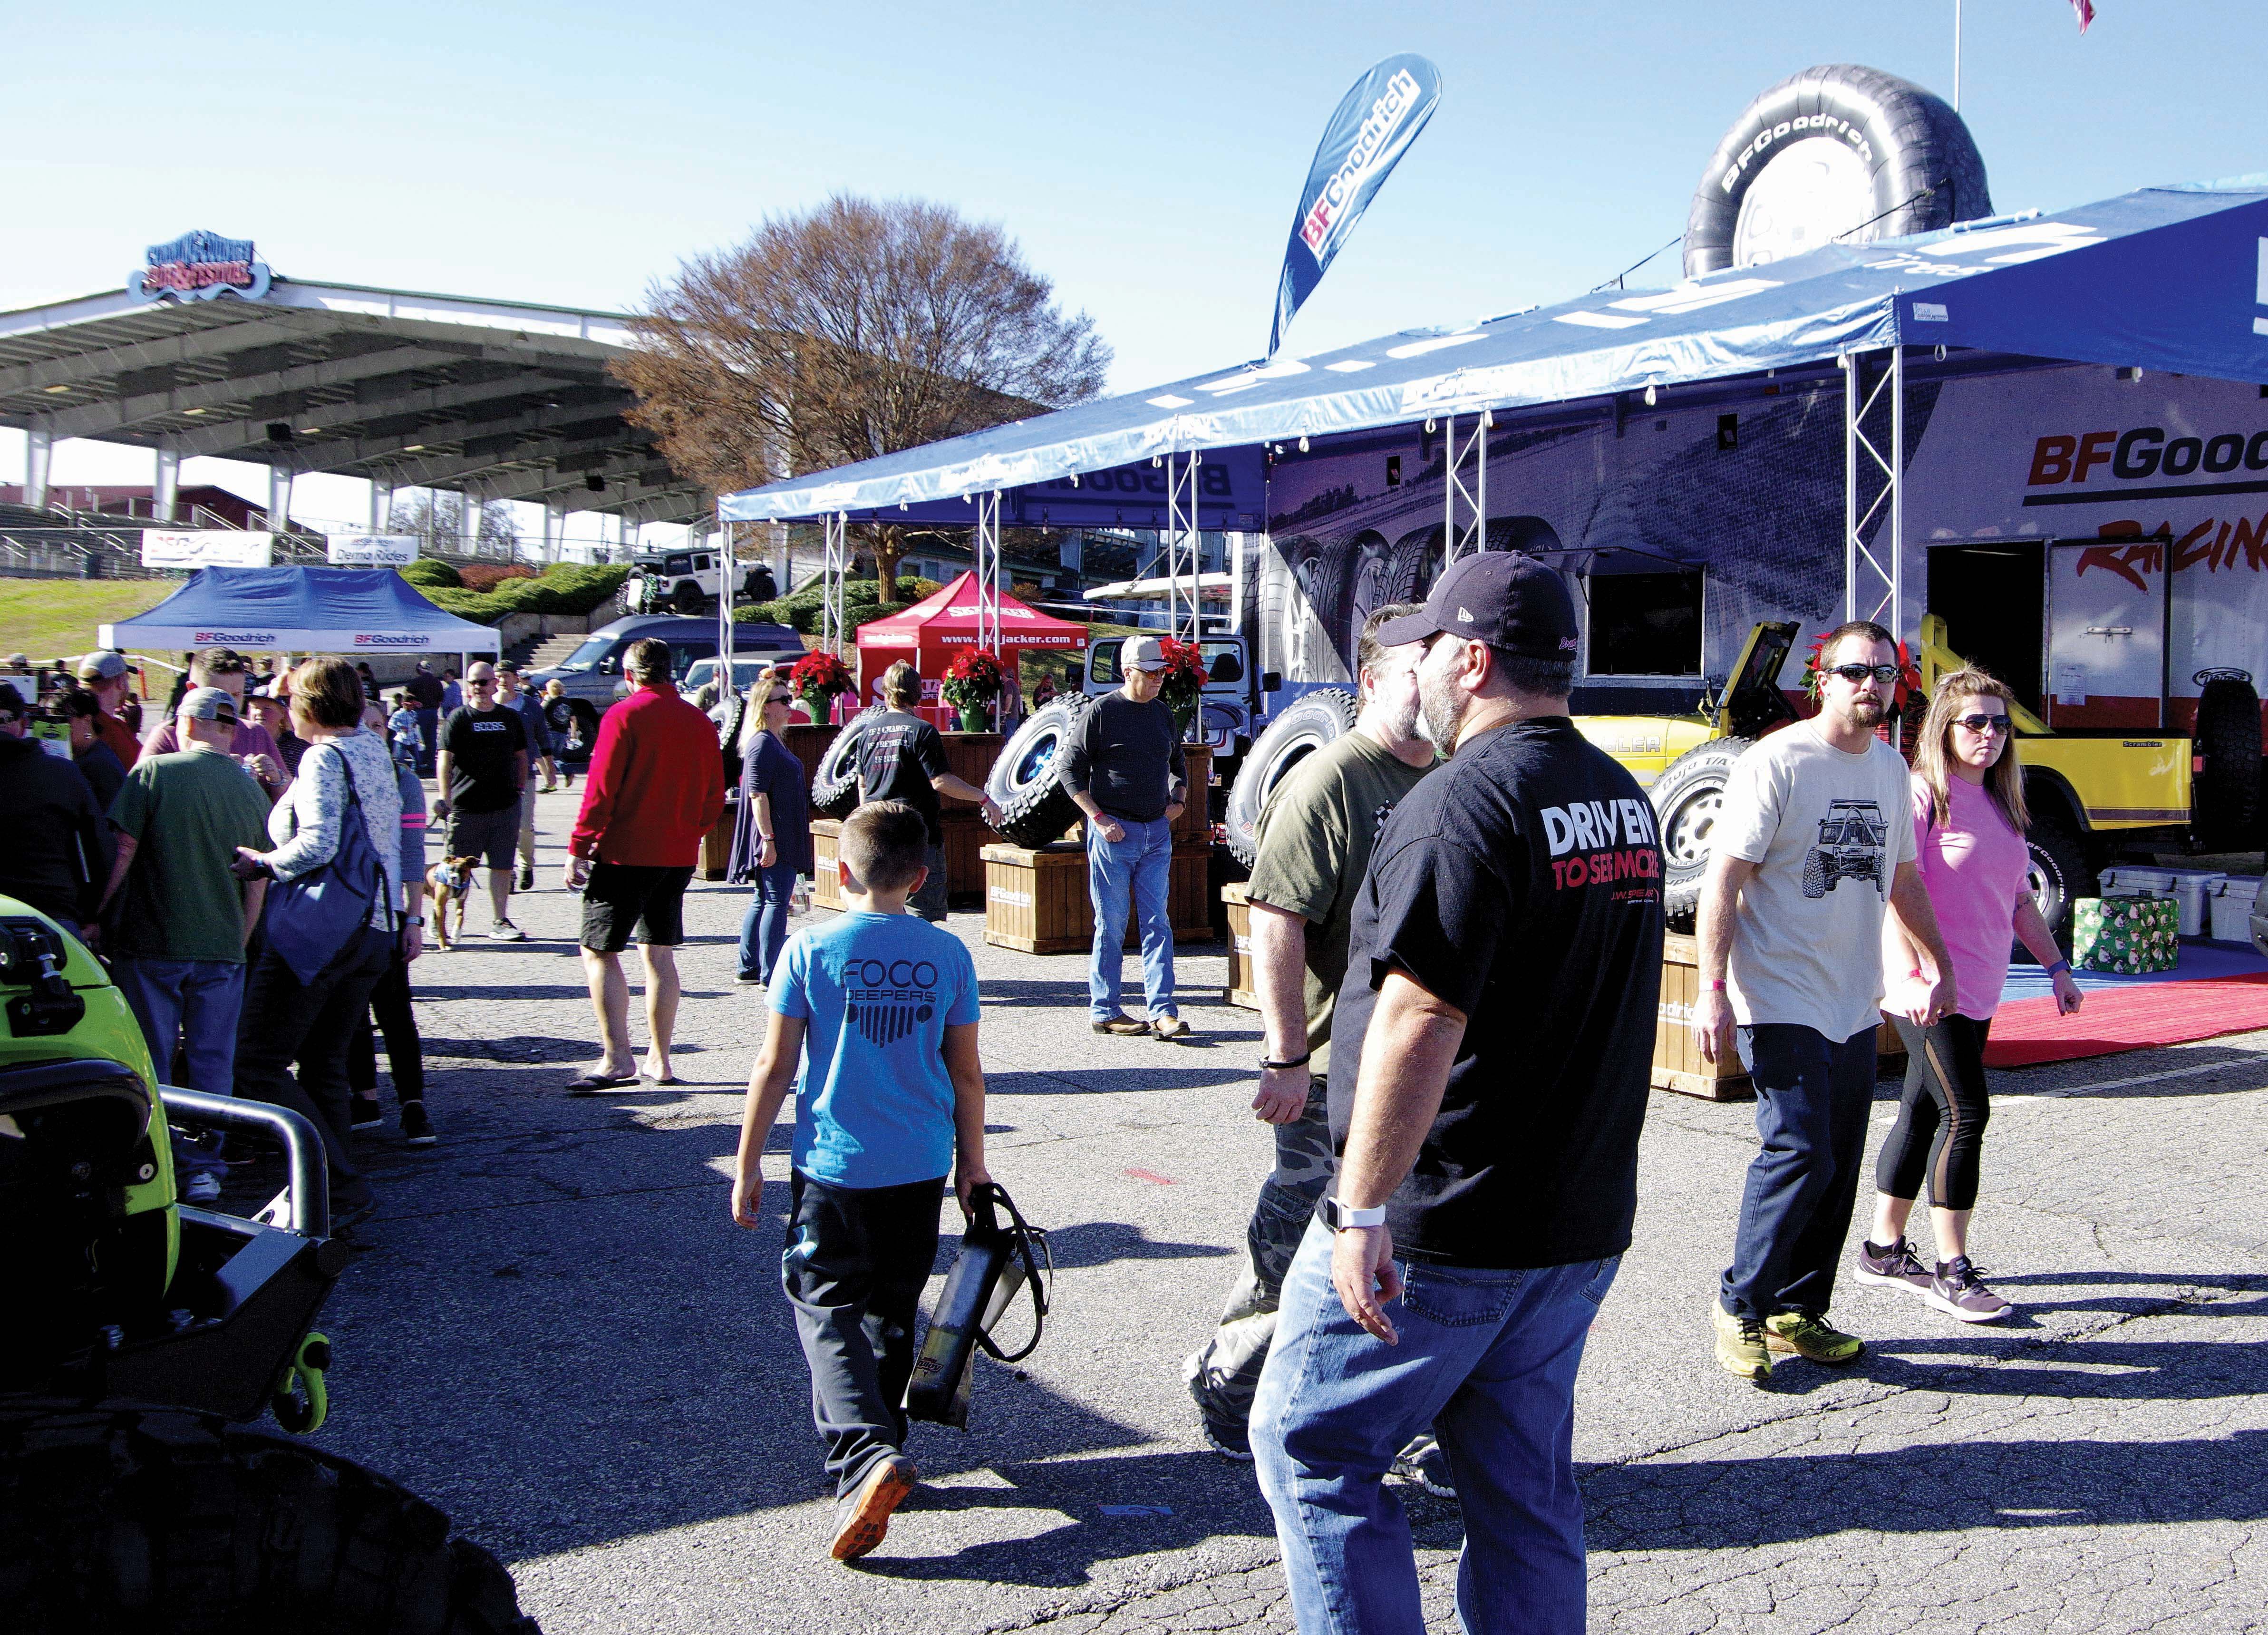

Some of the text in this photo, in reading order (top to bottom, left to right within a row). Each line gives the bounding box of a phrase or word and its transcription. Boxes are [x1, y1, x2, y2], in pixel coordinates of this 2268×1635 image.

[1302, 75, 1411, 249] BFGoodrich
[1722, 113, 1873, 193] BFGoodrich
[336, 549, 408, 561] Demo Rides
[195, 632, 275, 643] BFGoodrich
[354, 634, 429, 644] BFGoodrich
[1540, 799, 1656, 856] DRIVEN
[1552, 857, 1588, 890] TO
[1590, 853, 1613, 885] SEE
[1614, 849, 1659, 880] MORE
[2026, 841, 2065, 903] BFGoodrich
[990, 886, 1032, 904] BFGoodrich
[840, 959, 938, 989] FOCO
